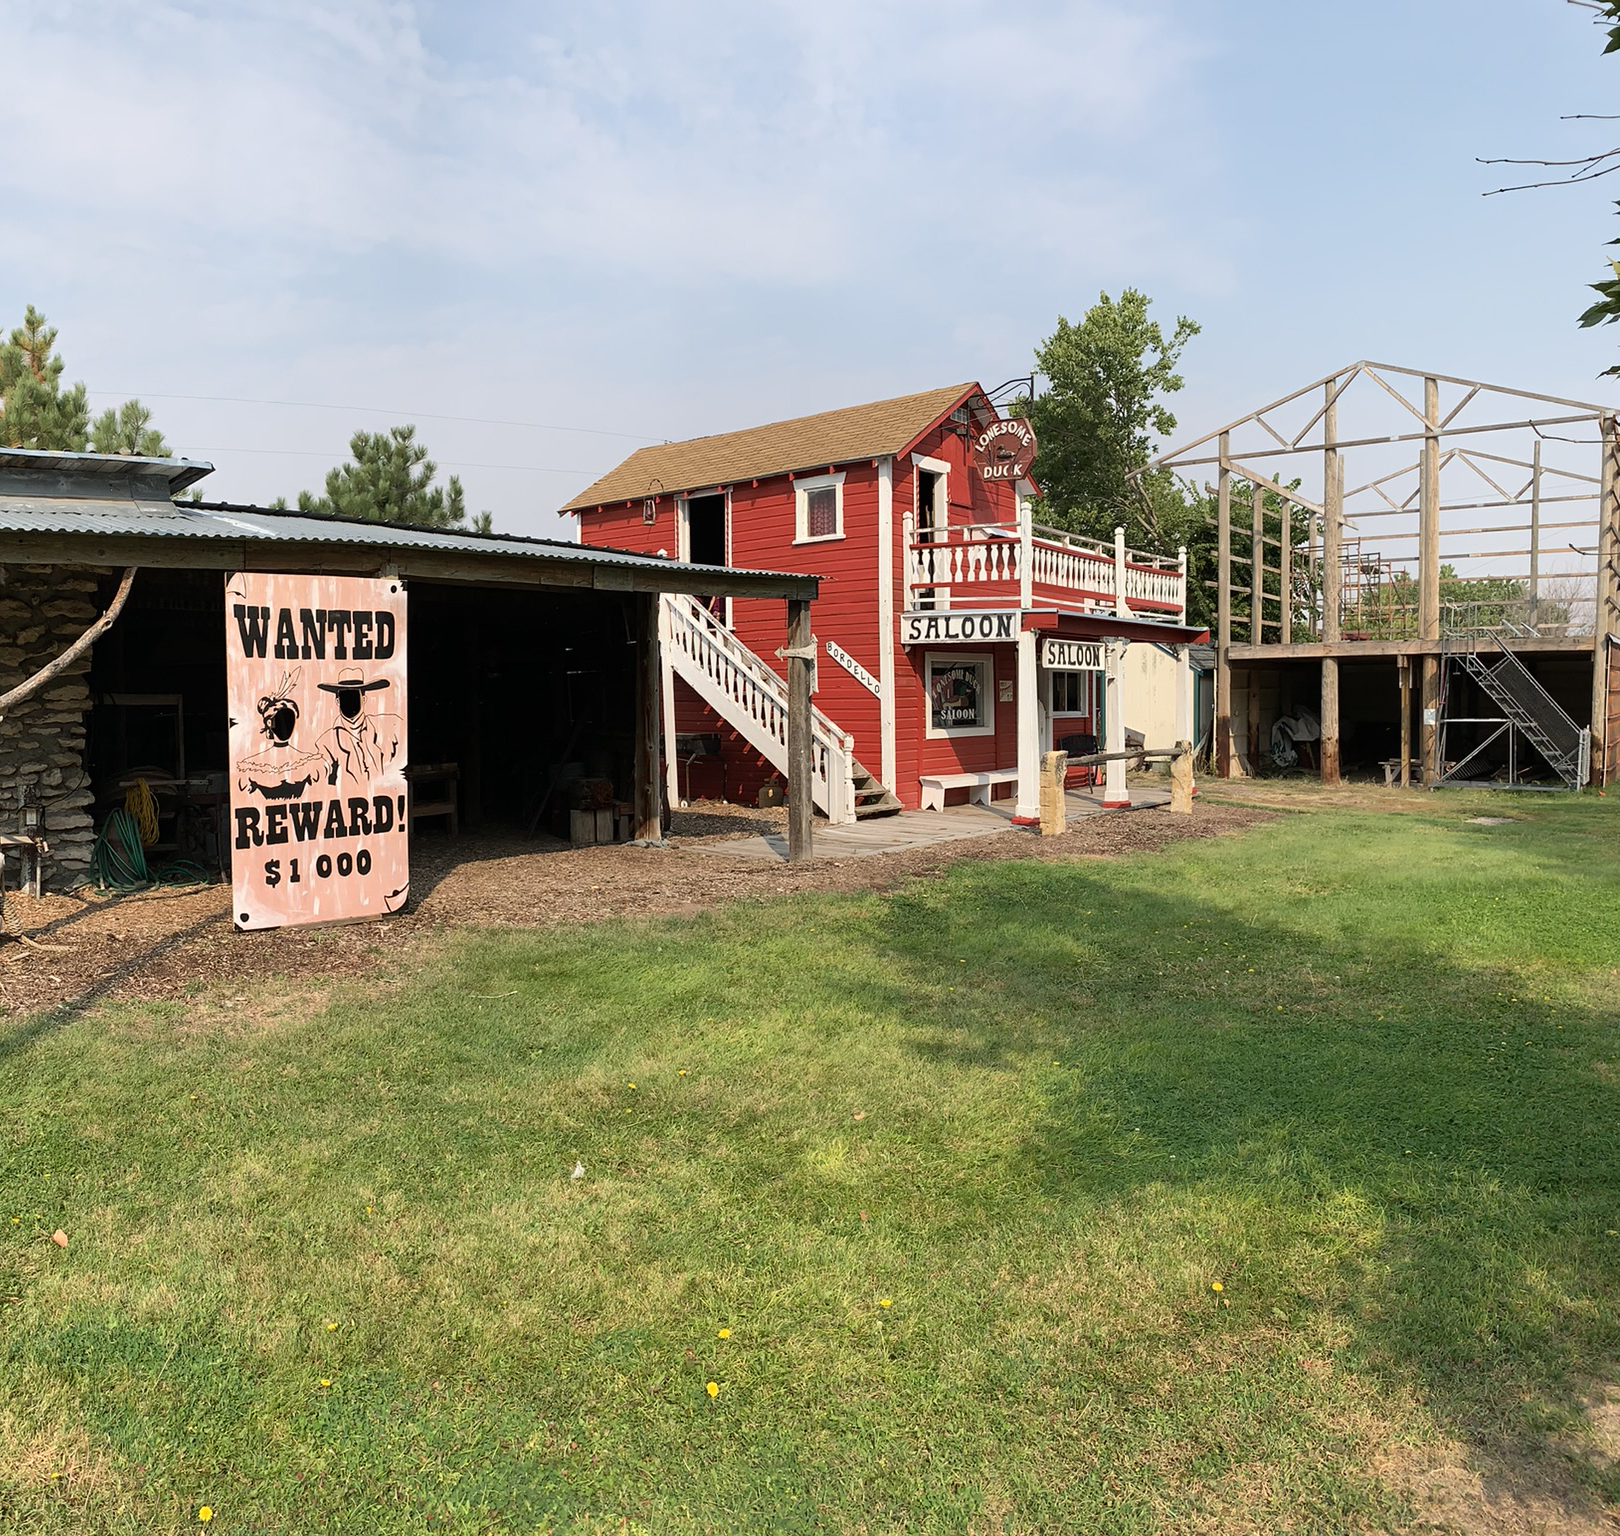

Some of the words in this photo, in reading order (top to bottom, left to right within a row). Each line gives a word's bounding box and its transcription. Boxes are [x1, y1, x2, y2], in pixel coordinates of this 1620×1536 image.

[975, 421, 1032, 453] LONESOME
[984, 464, 1023, 479] DUCK
[233, 604, 396, 660] WANTED
[909, 614, 1013, 640] SALOON
[827, 642, 880, 694] BORDELLO
[1047, 642, 1101, 667] SALOON
[932, 669, 964, 698] LONESOME
[965, 671, 981, 695] DUCK
[940, 708, 975, 720] SALOON
[235, 795, 406, 850] REWARD!
